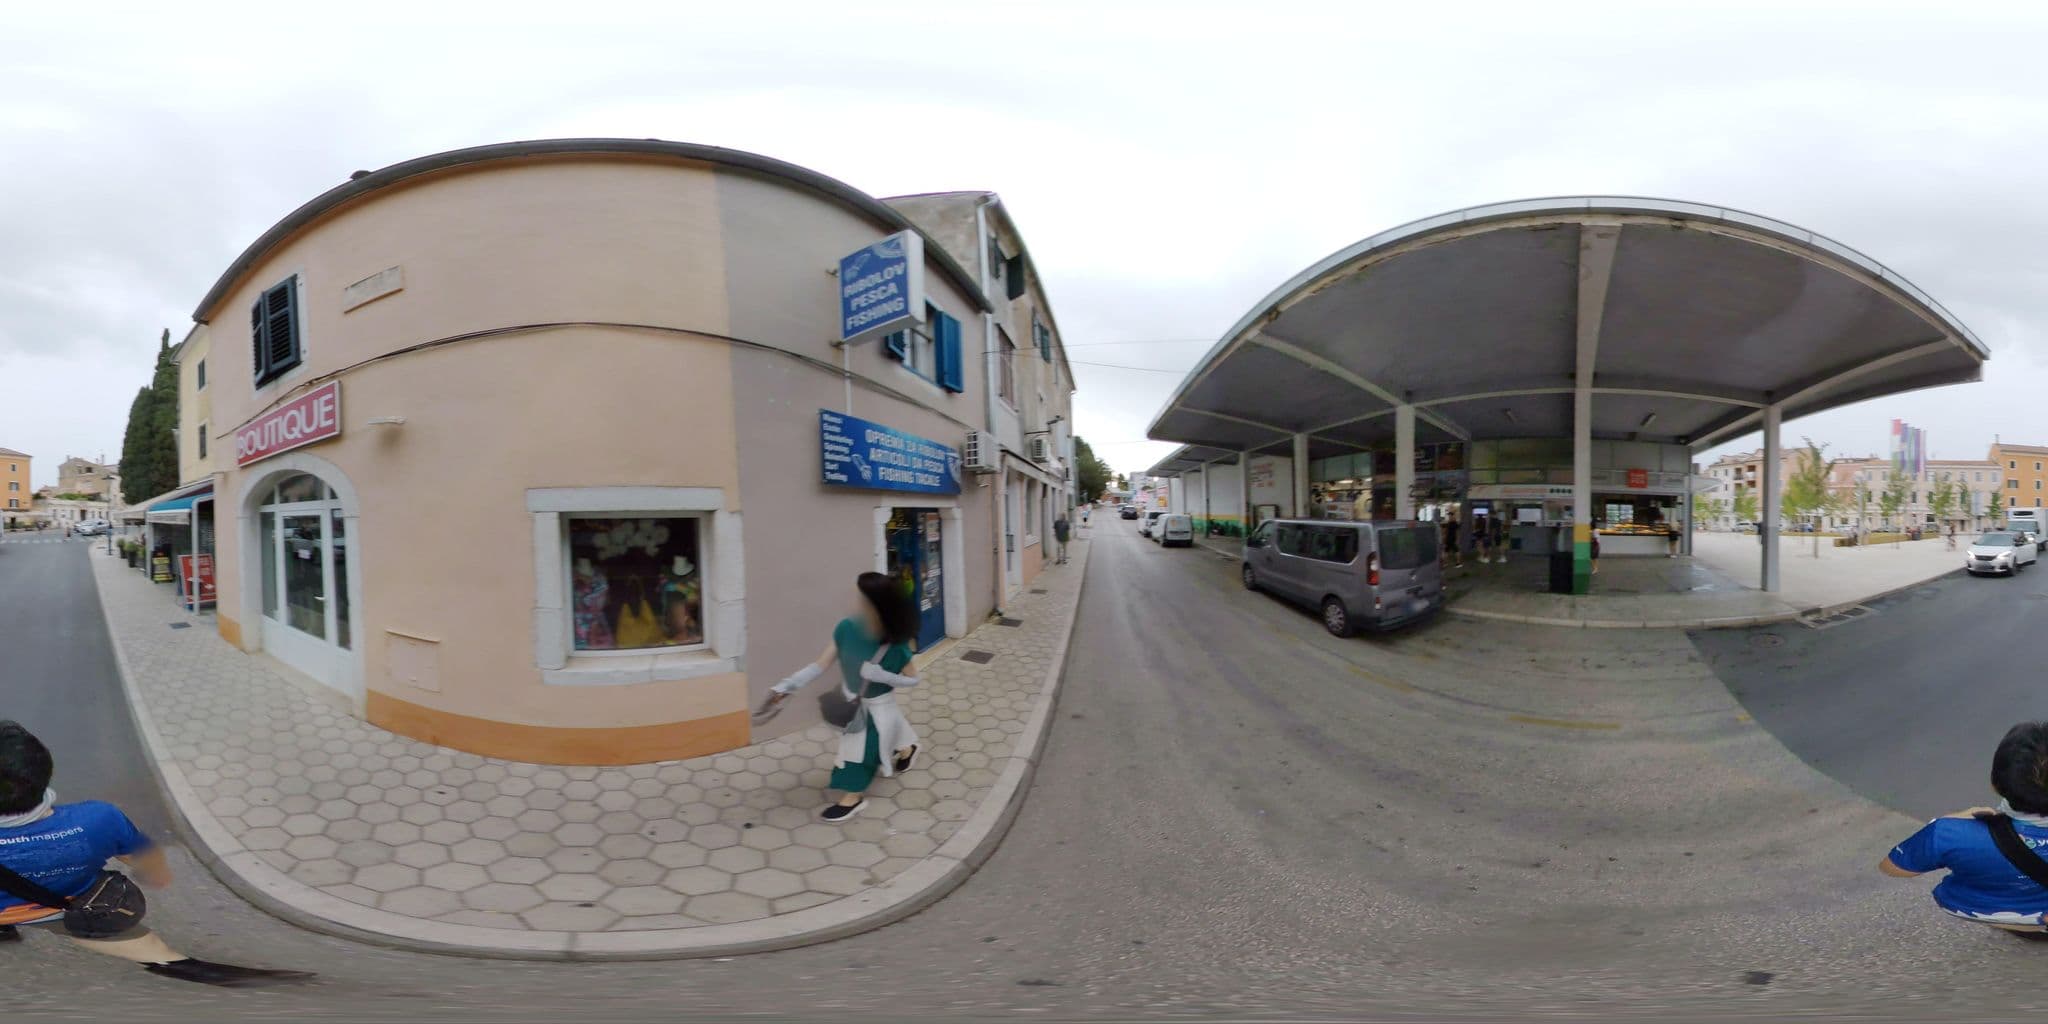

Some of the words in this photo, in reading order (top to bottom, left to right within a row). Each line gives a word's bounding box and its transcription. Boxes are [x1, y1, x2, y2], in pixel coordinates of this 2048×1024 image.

[844, 262, 905, 298] RIBOLOV
[851, 283, 898, 311] PESCA
[846, 297, 905, 331] FISHING
[238, 392, 335, 460] BOUTIQUE
[865, 429, 904, 450] OPREMA
[878, 466, 915, 484] FISHING
